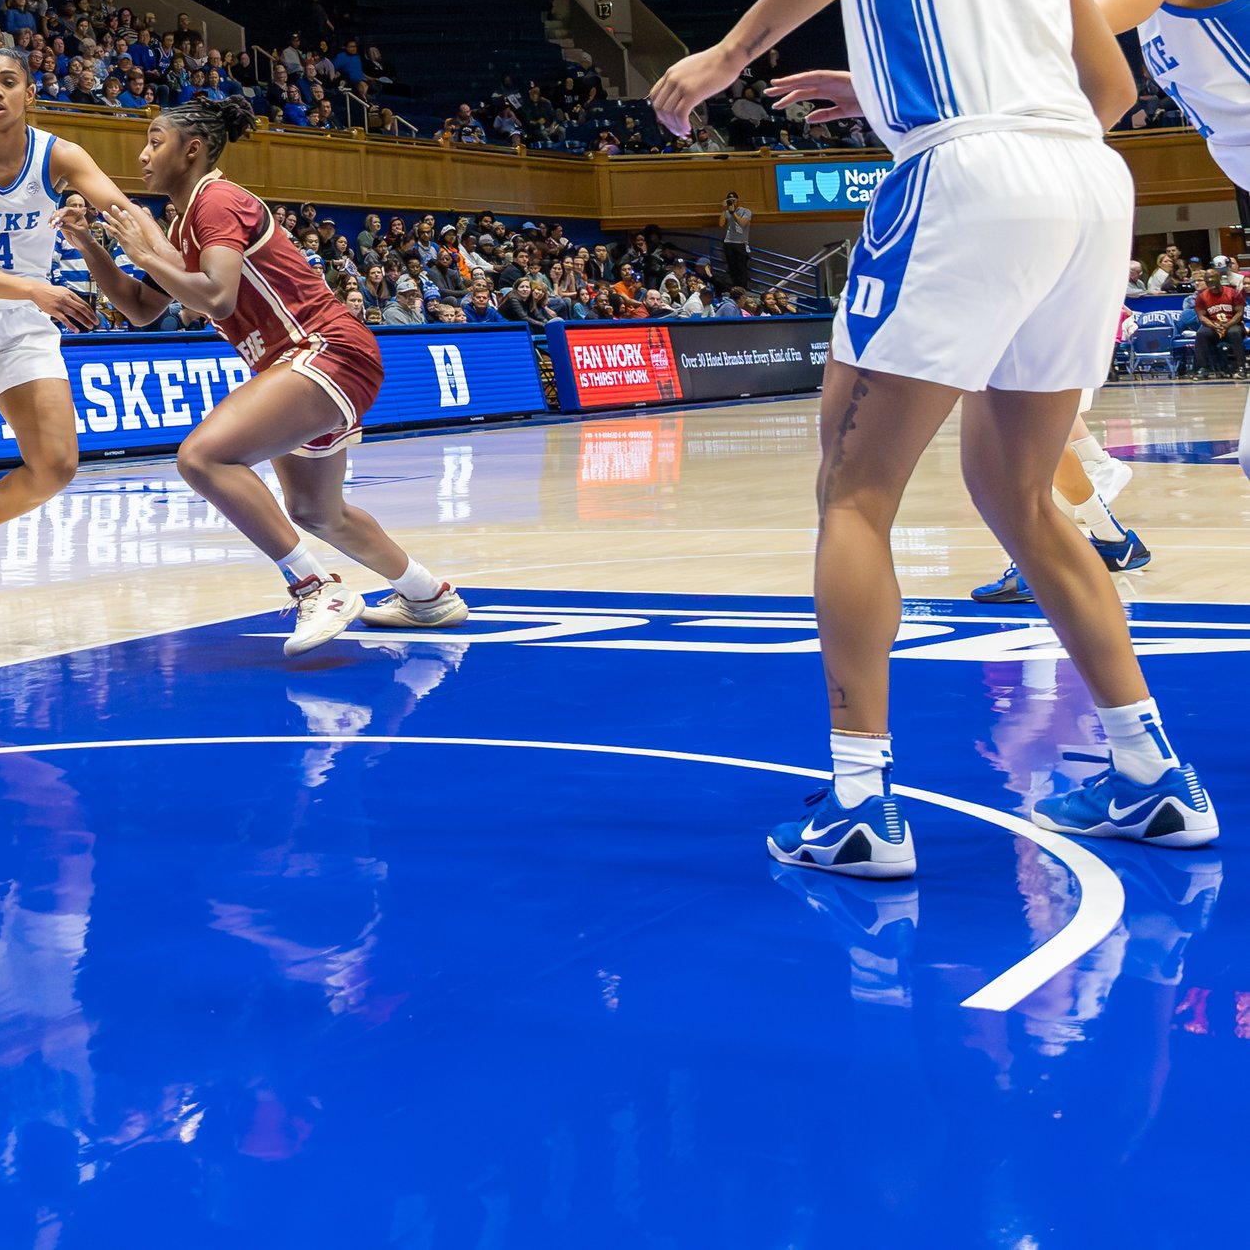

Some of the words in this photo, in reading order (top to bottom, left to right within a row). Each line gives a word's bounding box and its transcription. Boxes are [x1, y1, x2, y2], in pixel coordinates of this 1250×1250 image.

[849, 275, 884, 317] D
[1142, 313, 1166, 325] DUKE
[573, 345, 603, 370] FAN
[601, 343, 646, 368] WORK
[681, 353, 697, 368] Over
[697, 352, 706, 367] 30
[705, 352, 723, 367] Hotel
[723, 351, 744, 366] Brands
[743, 350, 753, 365] for
[753, 350, 770, 366] Every
[769, 349, 785, 363] Kind
[785, 348, 791, 362] of
[791, 348, 803, 362] Fan
[427, 345, 470, 407] D
[580, 373, 589, 388] IS
[590, 371, 624, 387] THIRSTY
[623, 369, 650, 384] WORK
